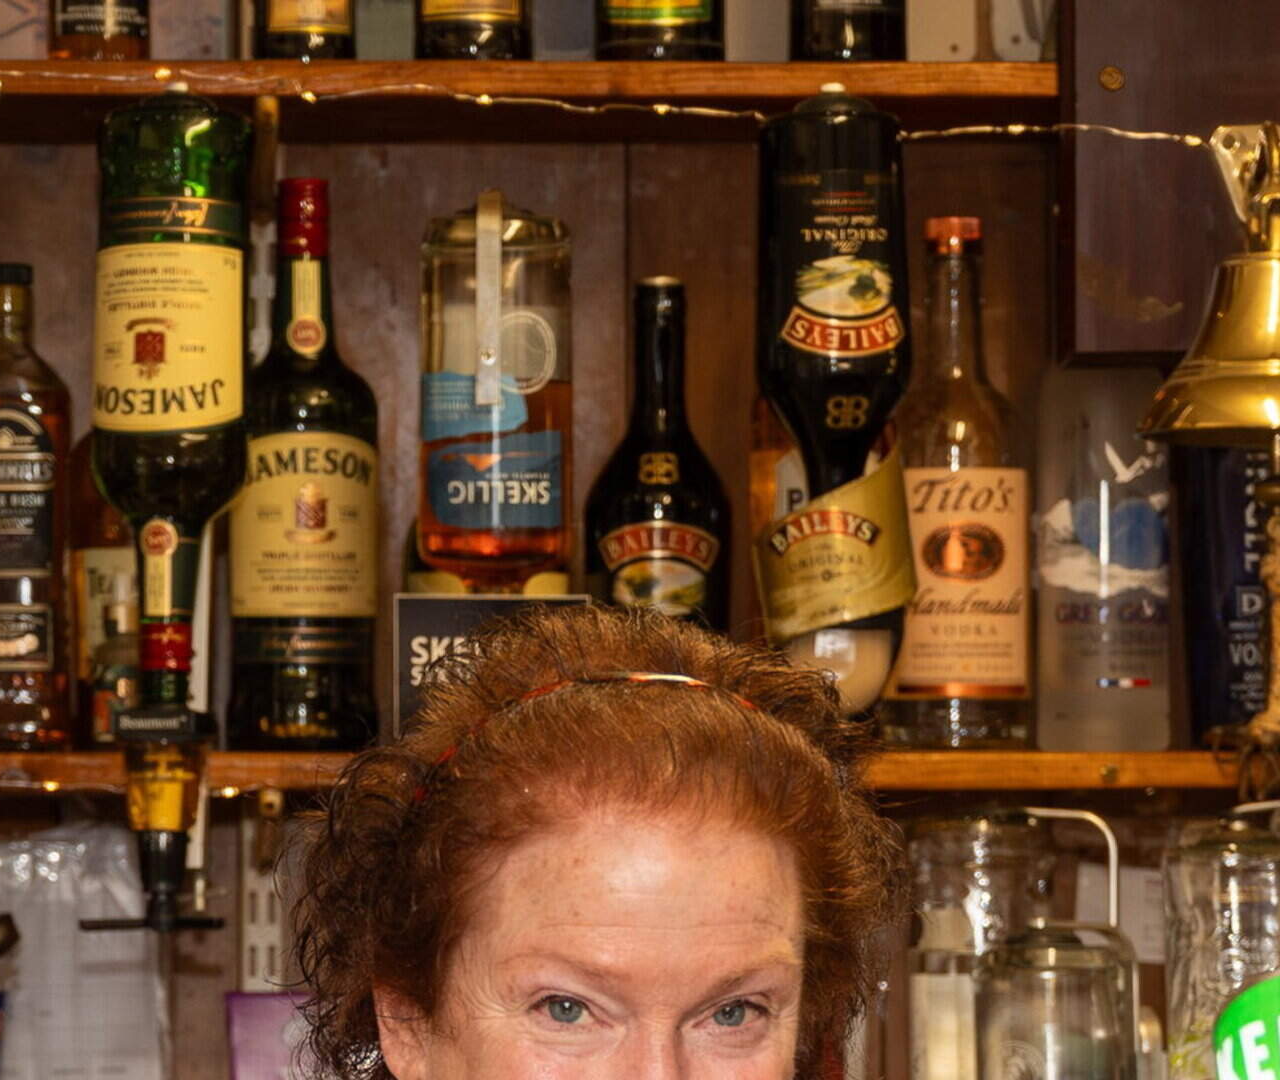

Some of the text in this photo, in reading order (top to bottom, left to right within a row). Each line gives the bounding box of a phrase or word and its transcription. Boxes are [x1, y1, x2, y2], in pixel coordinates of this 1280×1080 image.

[792, 316, 899, 351] BAILEYS
[447, 479, 552, 505] SKELLIG
[911, 474, 1015, 515] Tito's
[605, 522, 711, 558] BAILEYS
